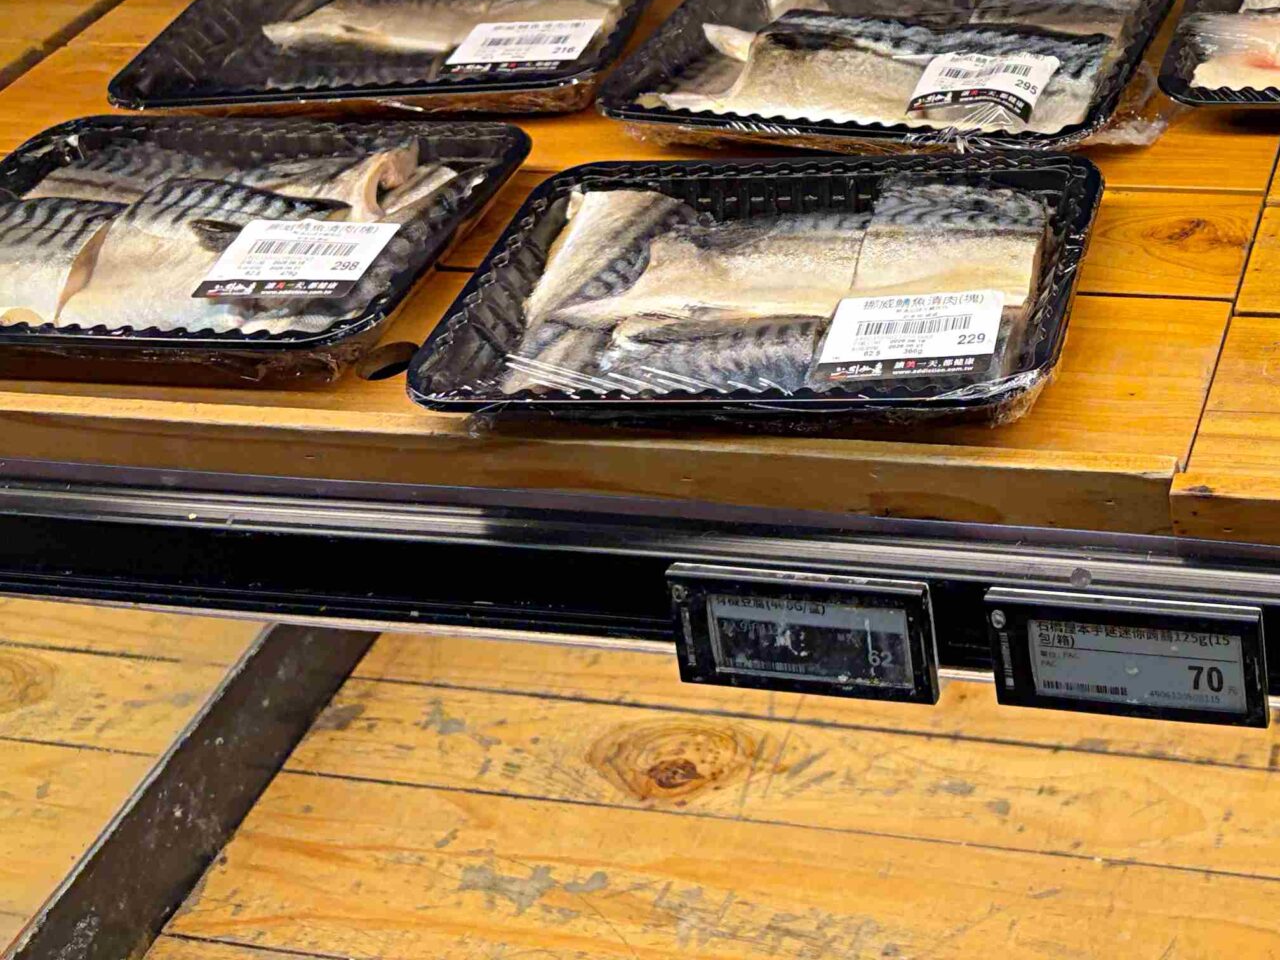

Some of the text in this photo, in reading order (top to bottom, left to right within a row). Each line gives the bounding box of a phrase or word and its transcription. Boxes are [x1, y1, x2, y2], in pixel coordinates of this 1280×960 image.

[1014, 79, 1039, 95] 295
[330, 261, 361, 271] 298
[957, 333, 986, 345] 229
[1187, 664, 1224, 693] 70
